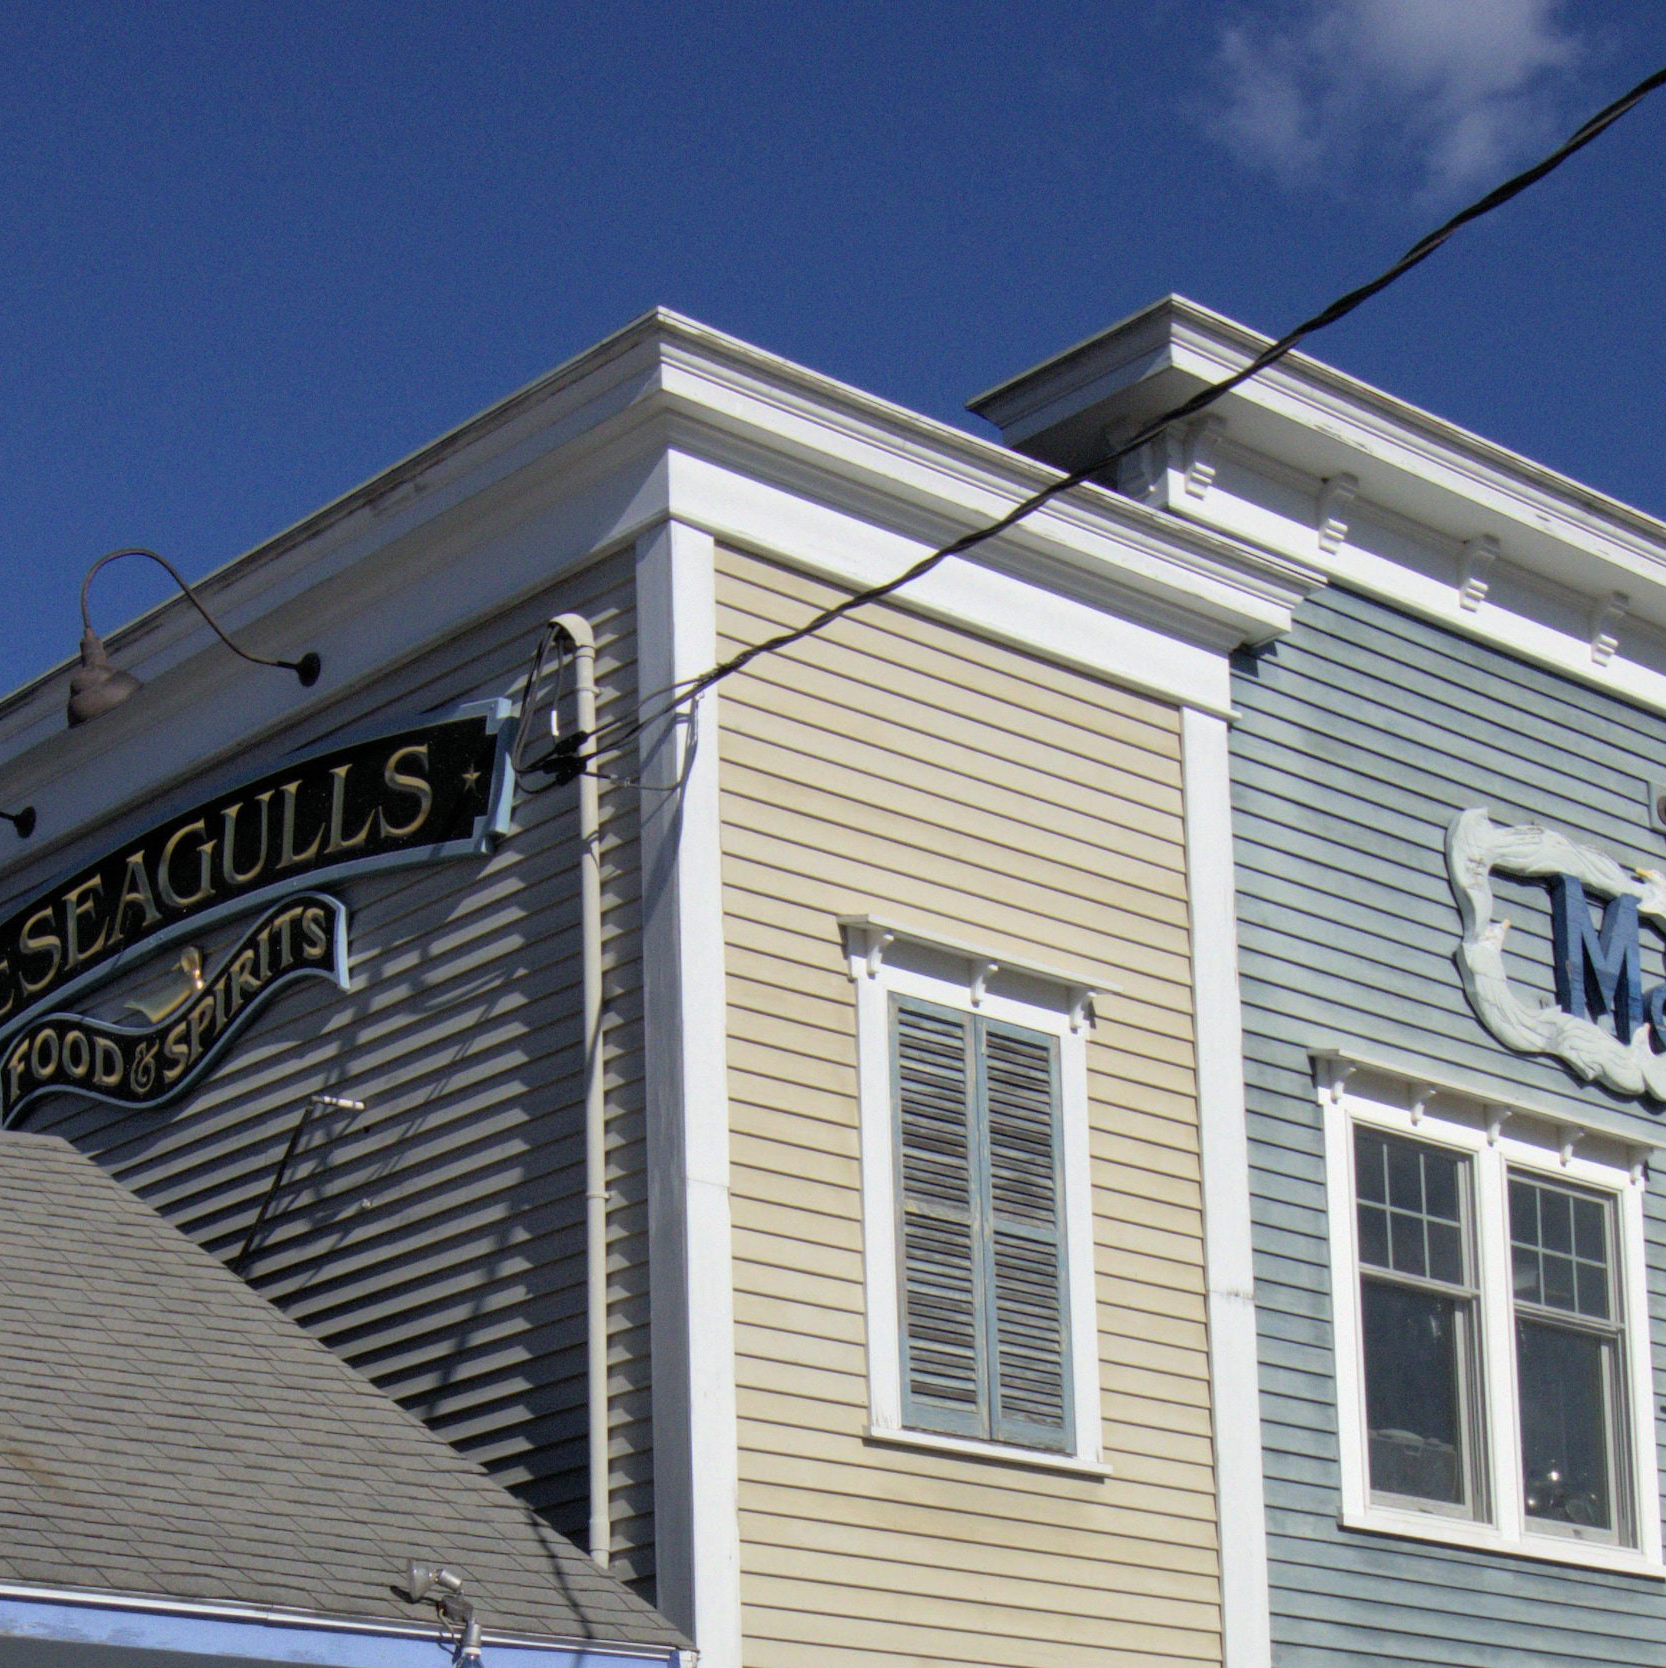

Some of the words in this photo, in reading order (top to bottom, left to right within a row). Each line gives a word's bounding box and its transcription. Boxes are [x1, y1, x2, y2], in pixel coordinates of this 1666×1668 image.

[8, 1029, 124, 1100] FOOD
[132, 1042, 158, 1095] &
[162, 907, 327, 1084] SPIRITS
